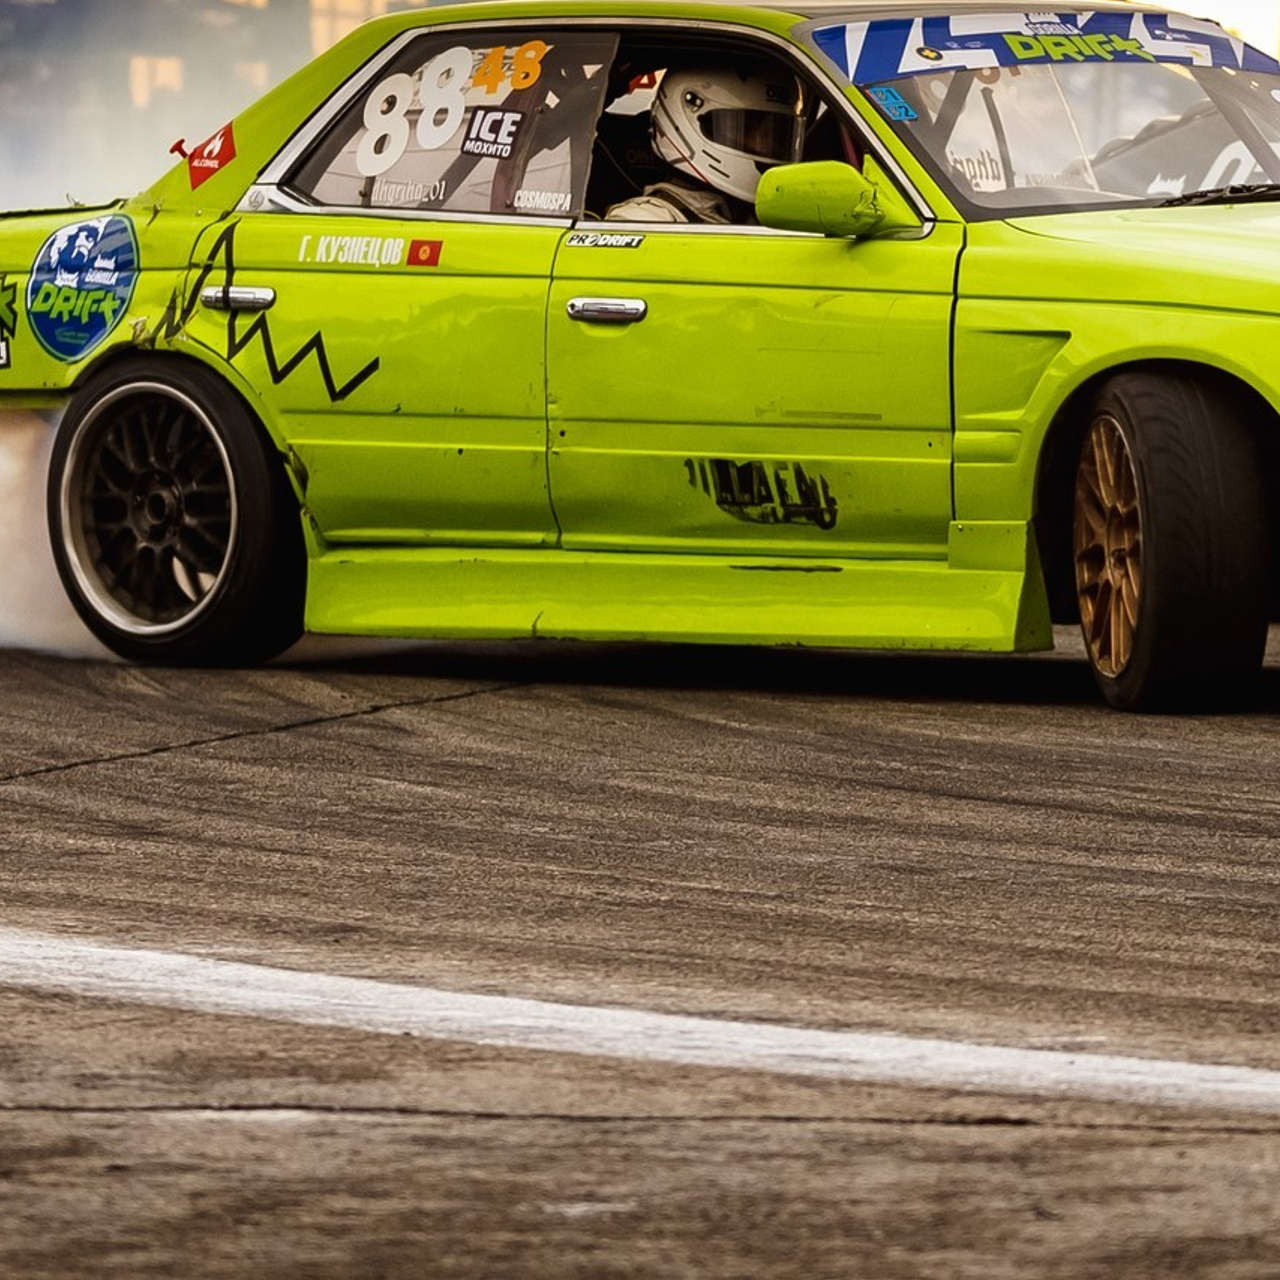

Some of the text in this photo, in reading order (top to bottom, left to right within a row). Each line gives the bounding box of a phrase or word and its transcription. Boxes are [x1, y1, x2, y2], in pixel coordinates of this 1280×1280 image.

[471, 40, 547, 94] 48
[356, 46, 473, 177] 88
[469, 110, 522, 145] ICE
[463, 140, 512, 158] МОХИТО
[513, 190, 572, 211] COSMOSPA
[298, 235, 405, 268] Г. КУЗНЕЦОВ
